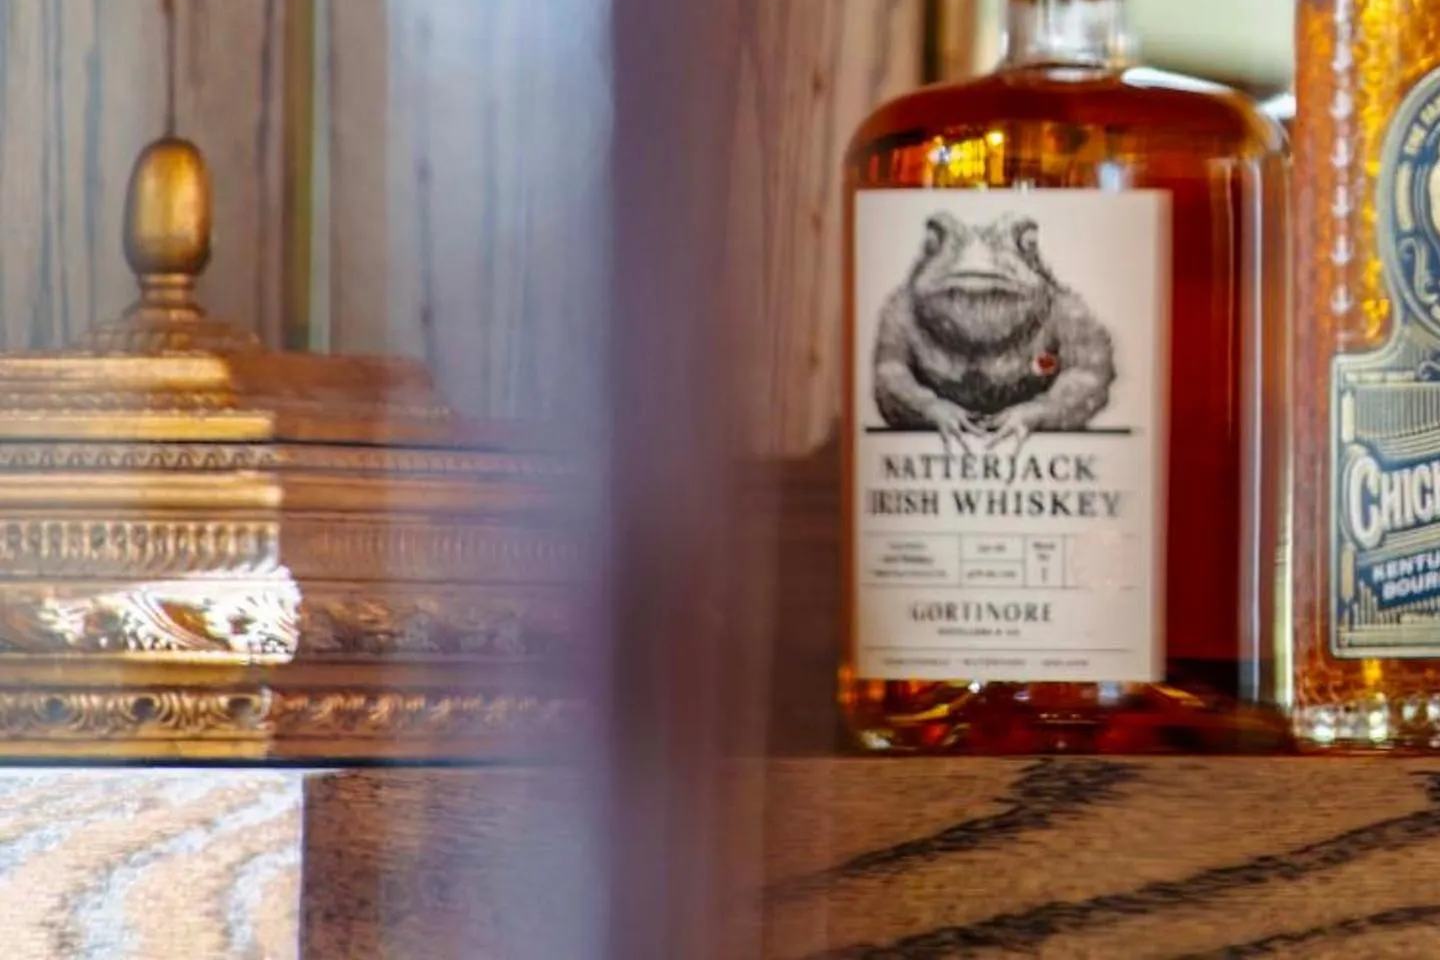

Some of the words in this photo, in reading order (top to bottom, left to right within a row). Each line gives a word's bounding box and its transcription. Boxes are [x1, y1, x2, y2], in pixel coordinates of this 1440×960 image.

[882, 453, 1097, 485] NATTERJACK
[868, 490, 939, 517] IRISH
[952, 490, 1121, 518] WHISKEY
[910, 601, 1053, 623] GORTINORE
